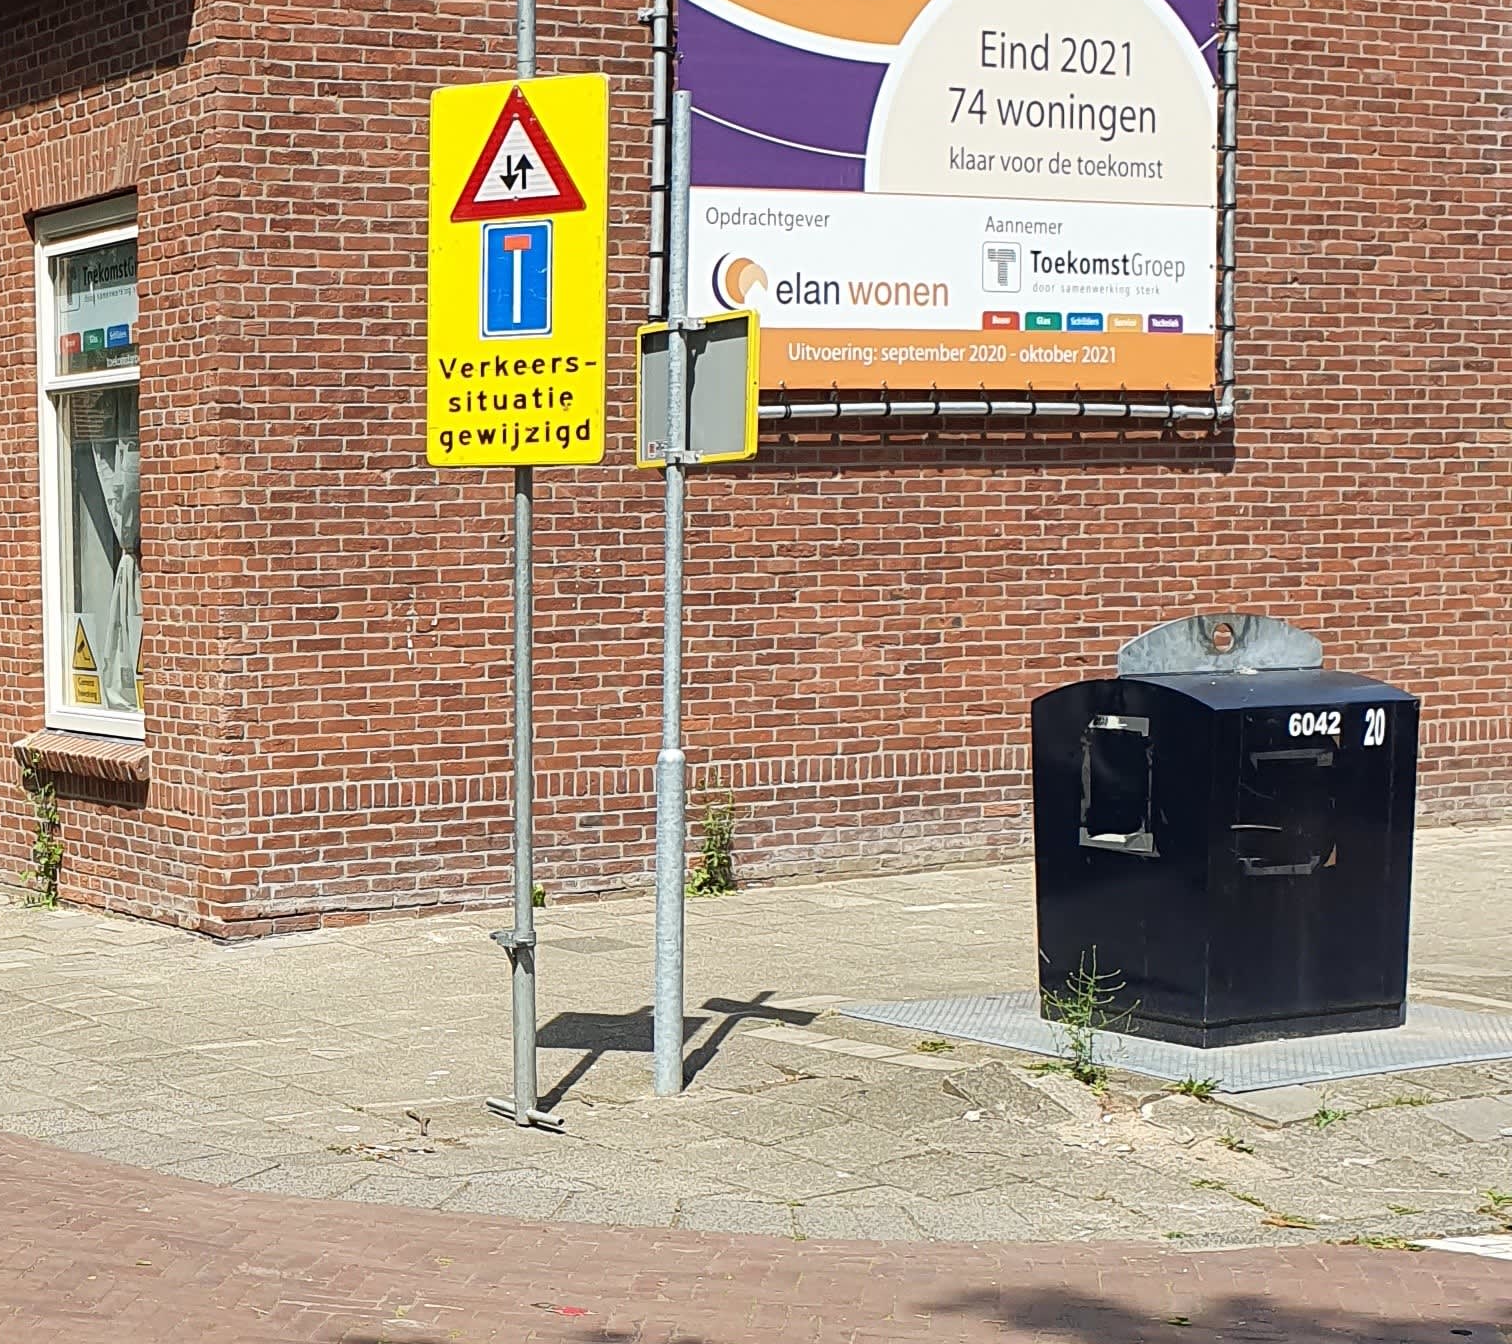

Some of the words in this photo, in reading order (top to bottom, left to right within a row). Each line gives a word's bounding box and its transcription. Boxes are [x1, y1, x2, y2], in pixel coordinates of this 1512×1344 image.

[981, 30, 1049, 71] Eind
[1060, 37, 1131, 77] 2021
[948, 86, 987, 125] 74
[996, 93, 1156, 142] woningen
[949, 145, 995, 172] klaar
[1000, 155, 1044, 174] voor
[1048, 151, 1072, 175] de
[1077, 153, 1164, 180] toekomst
[705, 206, 831, 232] Opdrachtgever
[984, 216, 1063, 236] Aannemer
[1029, 250, 1186, 283] ToekomstGroep
[775, 271, 840, 306] elan
[848, 280, 949, 307] wonen
[1032, 283, 1056, 293] door
[1060, 283, 1131, 297] samenwerking
[1136, 285, 1160, 296] sterk
[439, 354, 597, 380] Verkeers-
[787, 342, 877, 366] Uitvoering:
[880, 344, 965, 365] september
[968, 344, 1007, 362] 2020
[1019, 345, 1078, 364] oktober
[1080, 346, 1117, 364] 2021
[449, 386, 574, 413] situatie
[439, 417, 590, 453] gewijzigd
[1288, 711, 1341, 737] 6042
[1363, 707, 1386, 747] 20
